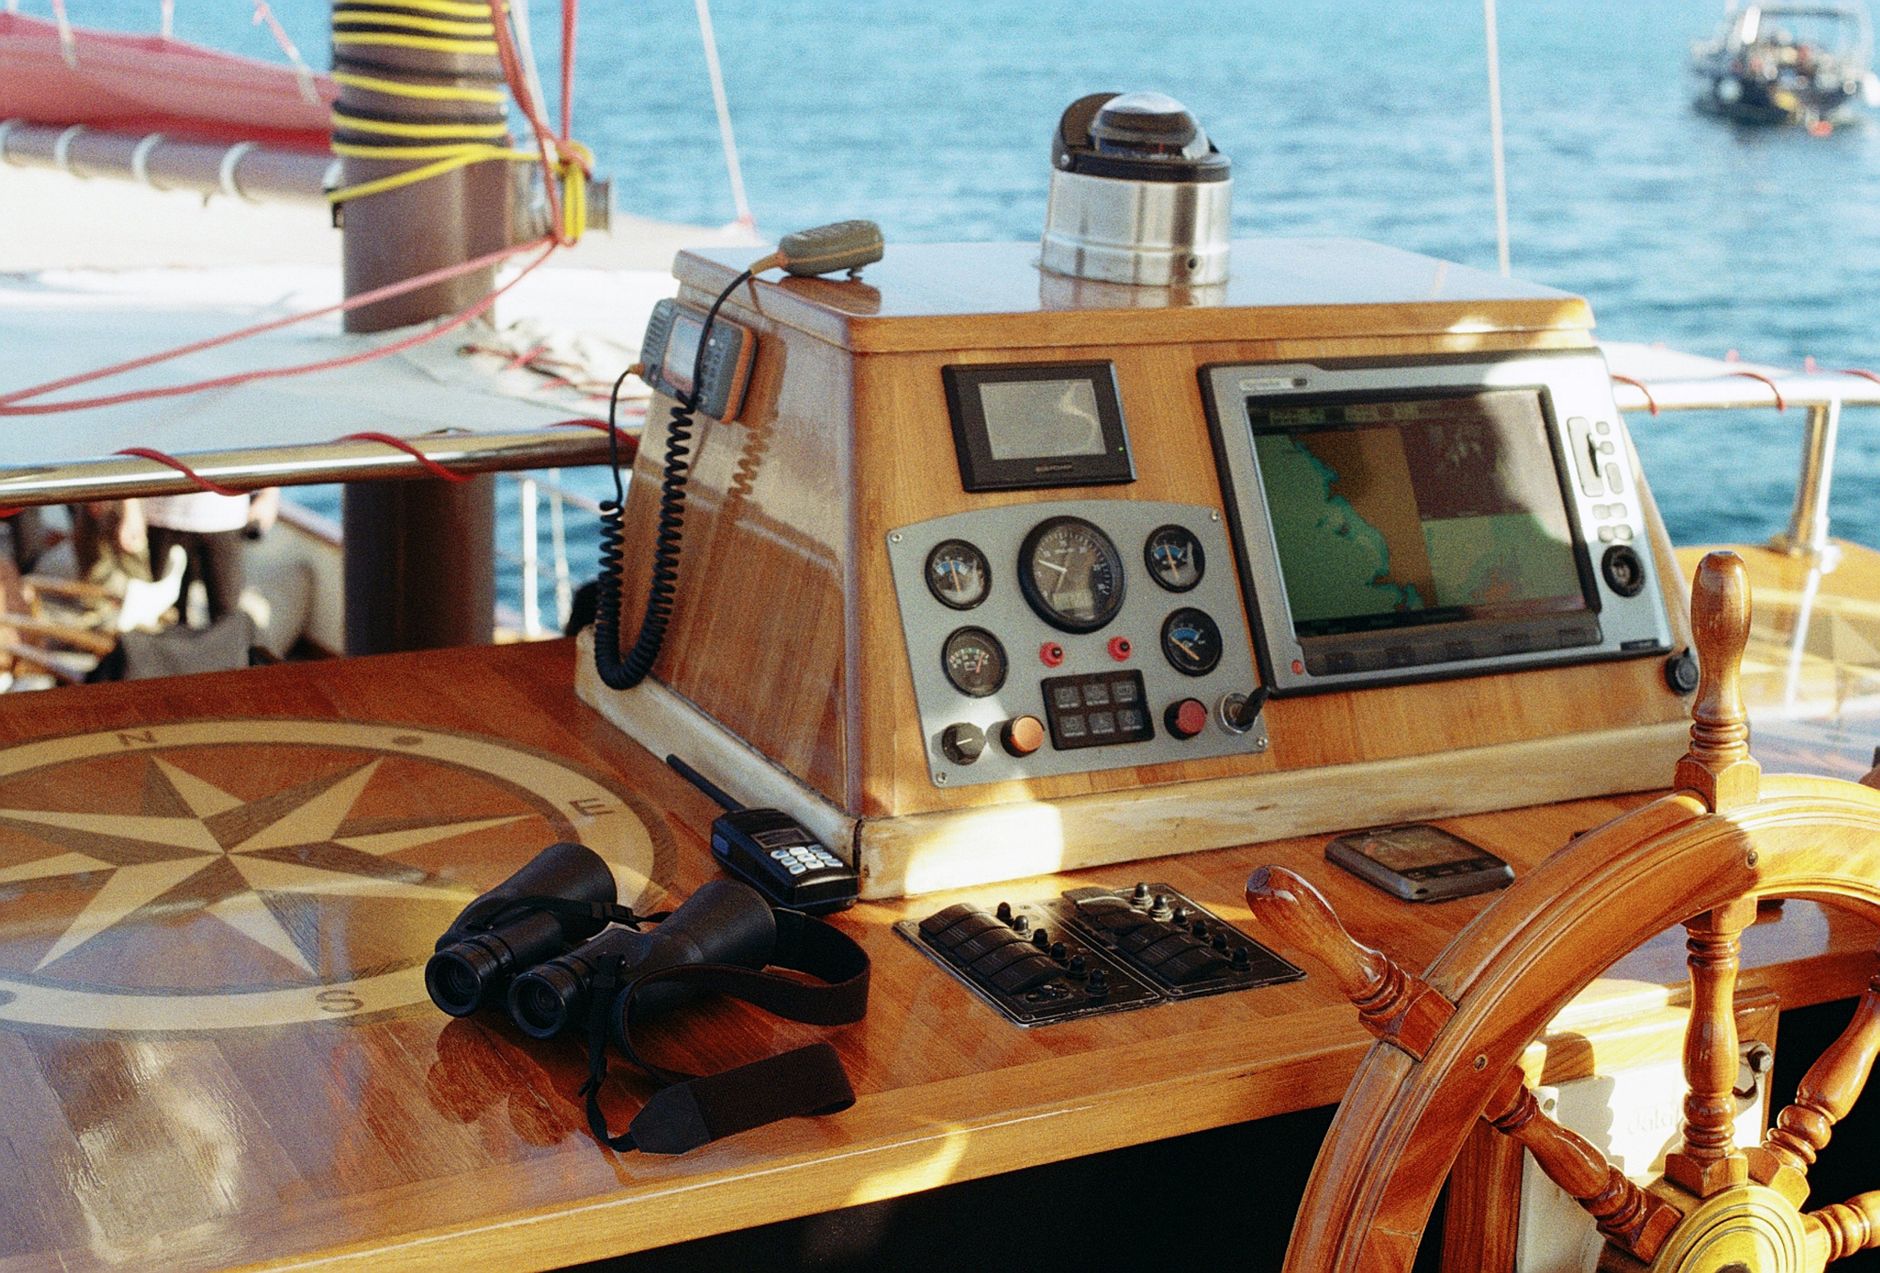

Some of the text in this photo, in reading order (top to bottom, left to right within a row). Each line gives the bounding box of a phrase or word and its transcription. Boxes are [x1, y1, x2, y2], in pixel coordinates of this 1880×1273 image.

[117, 730, 159, 746] N
[569, 798, 616, 816] E
[315, 989, 364, 1012] S
